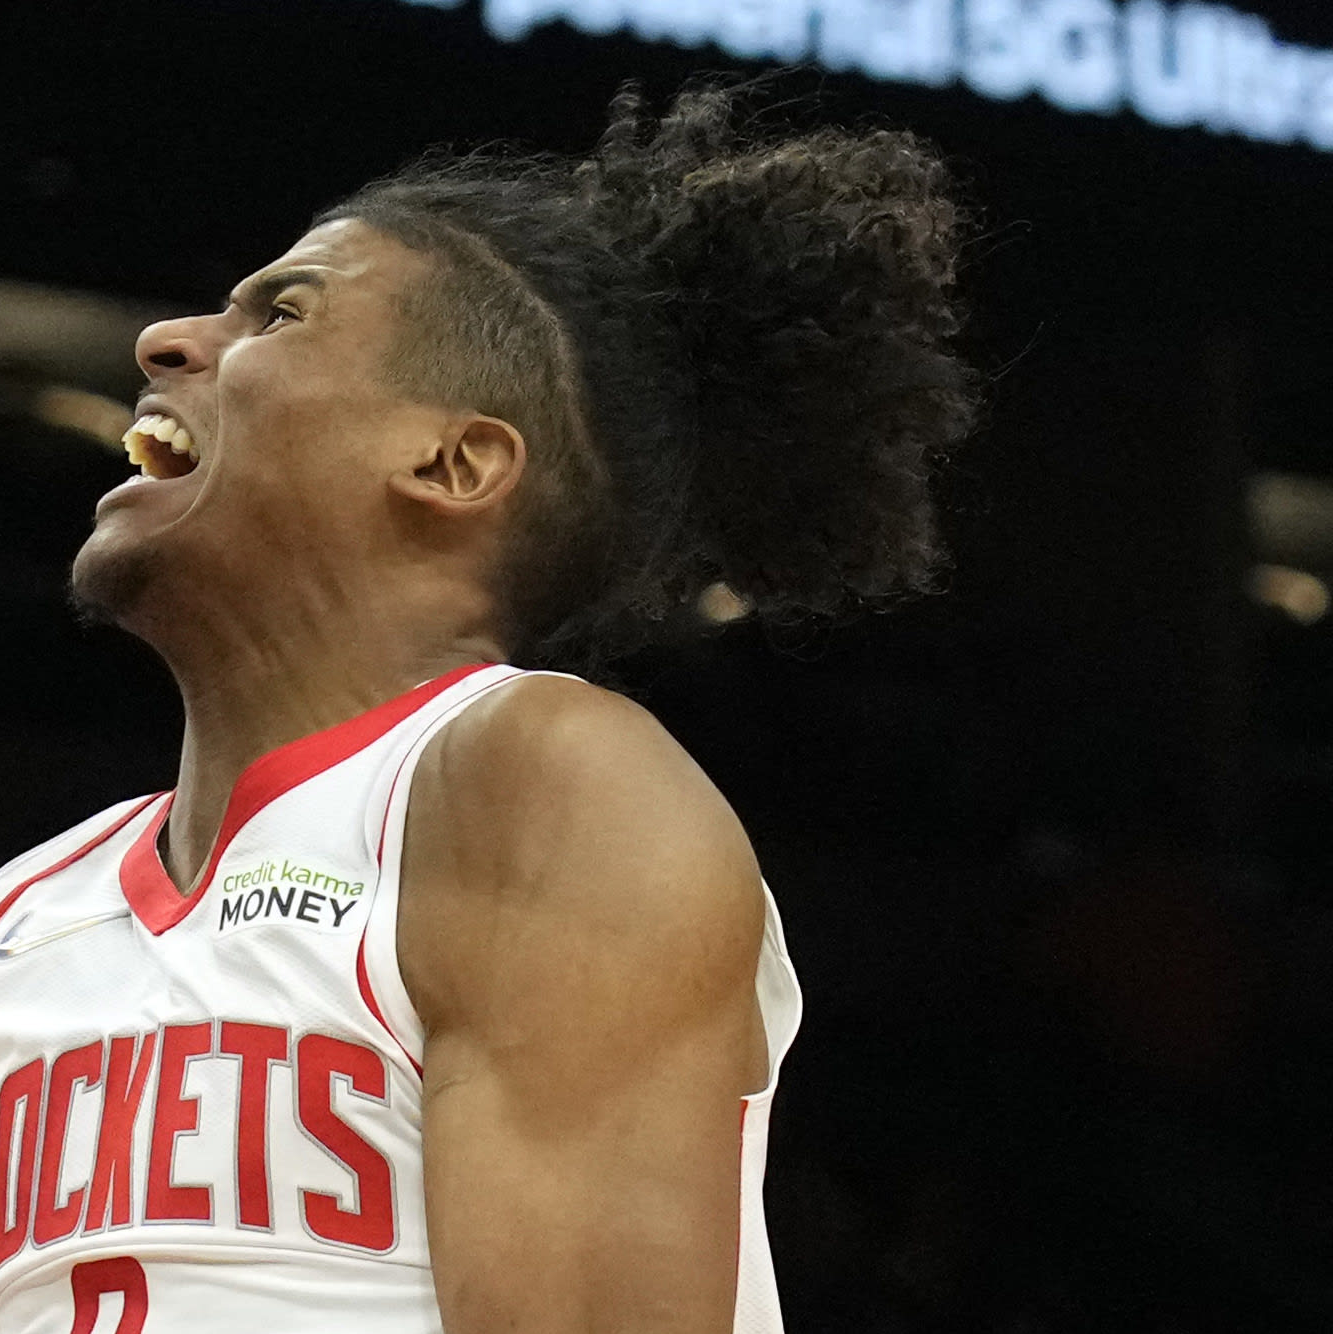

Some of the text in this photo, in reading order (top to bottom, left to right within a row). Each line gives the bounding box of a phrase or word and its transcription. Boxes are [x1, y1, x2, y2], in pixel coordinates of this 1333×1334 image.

[223, 860, 365, 897] credit karma
[219, 886, 358, 931] MONEY
